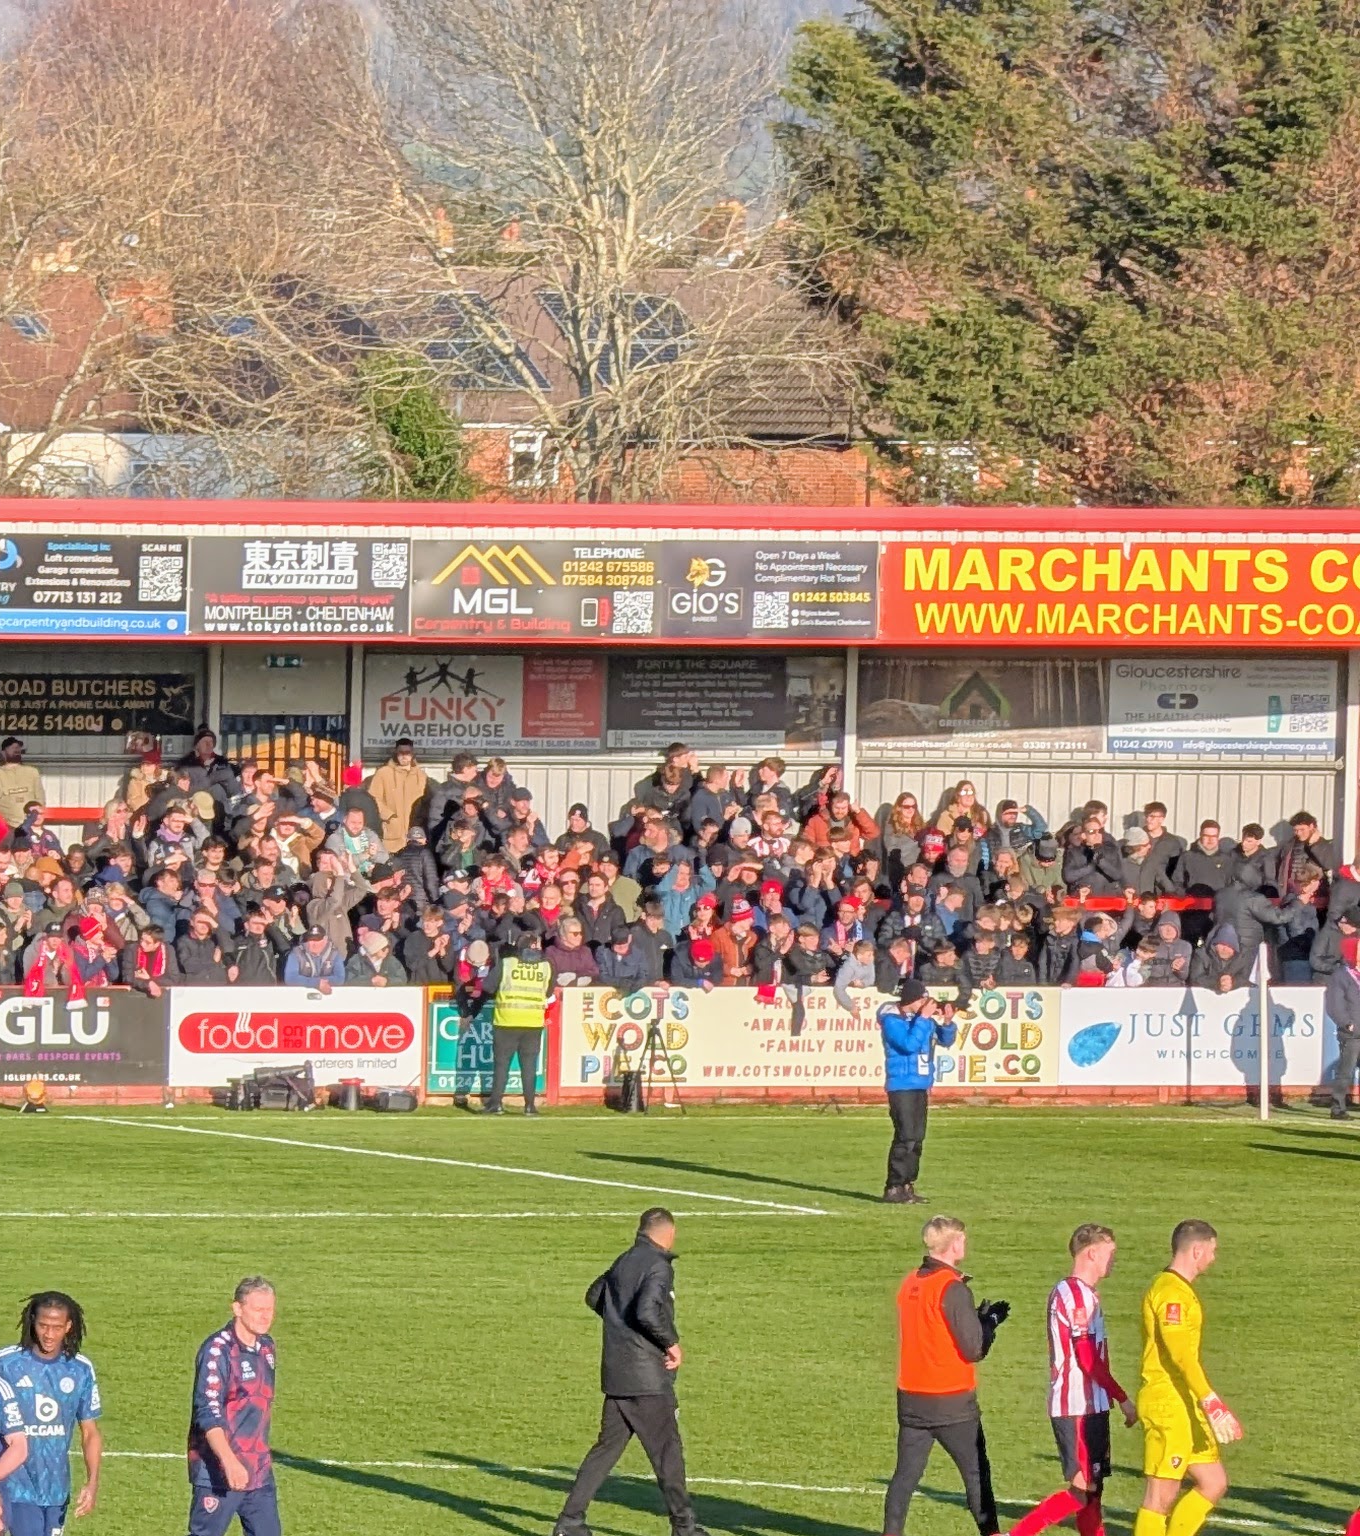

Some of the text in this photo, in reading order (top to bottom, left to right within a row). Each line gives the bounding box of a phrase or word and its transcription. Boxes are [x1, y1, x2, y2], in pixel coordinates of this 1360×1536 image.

[141, 543, 166, 552] SCAN
[44, 554, 113, 564] Loft conversions
[243, 540, 359, 571] 東京刺青
[755, 551, 841, 562] Open Week
[37, 565, 119, 576] Garage conversions
[562, 561, 655, 573] 01242 675586
[755, 562, 868, 574] No Appointment Necessary
[903, 547, 1289, 593] MARCHANTS
[25, 577, 131, 588] Extensions Renovations
[562, 574, 655, 586] 07584 308748
[754, 574, 861, 585] Complimentary Towel
[33, 591, 122, 605] 07713 131 212
[453, 588, 534, 615] MGL
[792, 592, 871, 602] 01242 503845
[204, 605, 394, 621] MONTPELLIER CHELTENHAM
[204, 621, 394, 633] www.tokyotattoo.co.uk
[414, 617, 571, 633] Carpentry Building
[1115, 663, 1242, 681] Gloucestershire
[51, 679, 157, 697] BUTCHERS
[380, 696, 505, 722] FUNKY
[380, 722, 505, 738] WAREHOUSE
[1113, 740, 1140, 750] 01242
[1141, 740, 1174, 750] 437910
[511, 969, 545, 983] CLUB
[583, 990, 690, 1021] THE COTS
[197, 1016, 405, 1050] food on move
[1127, 1012, 1206, 1044] JUST
[766, 1039, 867, 1053] FAMILY RUN
[37, 1052, 81, 1061] BESPOKE
[83, 1052, 122, 1061] EVENTS
[356, 1057, 398, 1069] limited
[935, 1054, 987, 1083] PIE
